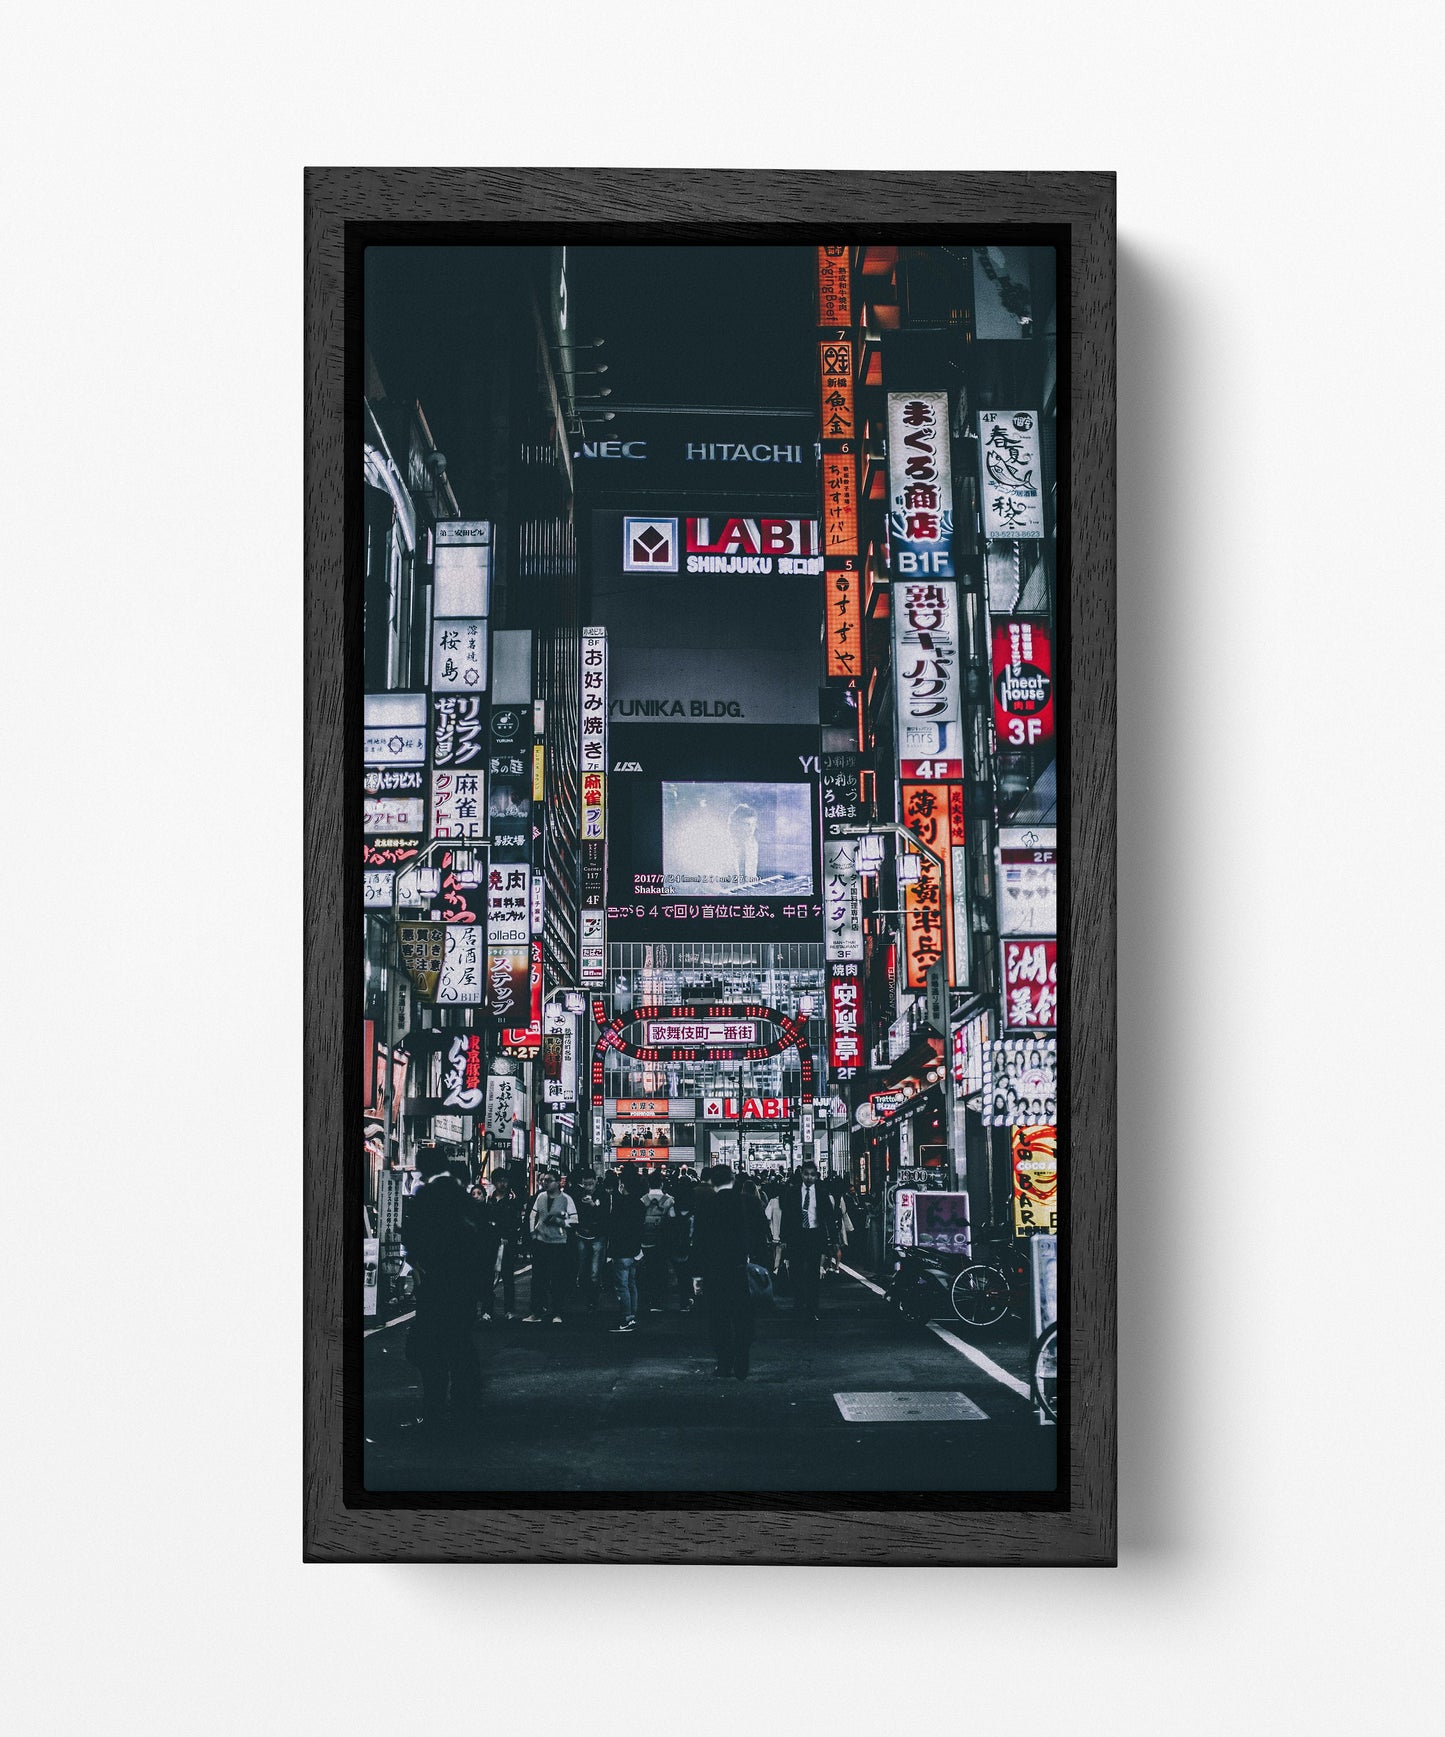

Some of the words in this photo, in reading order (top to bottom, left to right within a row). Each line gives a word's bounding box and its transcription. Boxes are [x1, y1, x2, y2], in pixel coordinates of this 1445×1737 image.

[836, 330, 845, 341] 7
[825, 391, 851, 436] 魚金
[982, 413, 998, 423] 4F
[576, 441, 648, 459] NEC
[687, 442, 802, 463] HITACHI
[842, 444, 849, 454] 6
[903, 401, 939, 540] まぐろ商店
[828, 465, 846, 544] ちびすけバル
[686, 518, 817, 555] LABI
[687, 556, 772, 574] SHINJUKU
[845, 560, 852, 571] 5
[899, 552, 949, 574] B1F
[834, 593, 856, 673] すずや
[440, 630, 461, 682] 桜島
[901, 585, 956, 717] 熟女キャバクラ
[1005, 664, 1050, 688] meat
[584, 648, 603, 761] お好み焼き
[1002, 681, 1045, 712] house
[608, 700, 686, 717] YUNIKA
[690, 701, 745, 718] BLDG.
[455, 696, 483, 765] リラク
[1008, 718, 1042, 745] 3F
[587, 762, 601, 770] 7F
[916, 760, 949, 779] 4F
[454, 773, 478, 818] 麻雀
[1034, 851, 1053, 863] 2F
[587, 895, 601, 905] 4F
[634, 885, 678, 894] Shakatak
[829, 873, 848, 937] バンタイ
[402, 943, 442, 957] 客引き
[458, 927, 478, 986] 居酒屋
[832, 964, 858, 977] 焼肉
[490, 957, 514, 1016] ステップ
[460, 993, 480, 1003] B1F
[651, 1025, 753, 1041] 歌舞伎町一番街
[466, 1034, 481, 1089] 東京豚骨
[836, 1067, 857, 1080] 2F
[494, 1081, 513, 1133] お好み焼き
[724, 1098, 790, 1119] LABI
